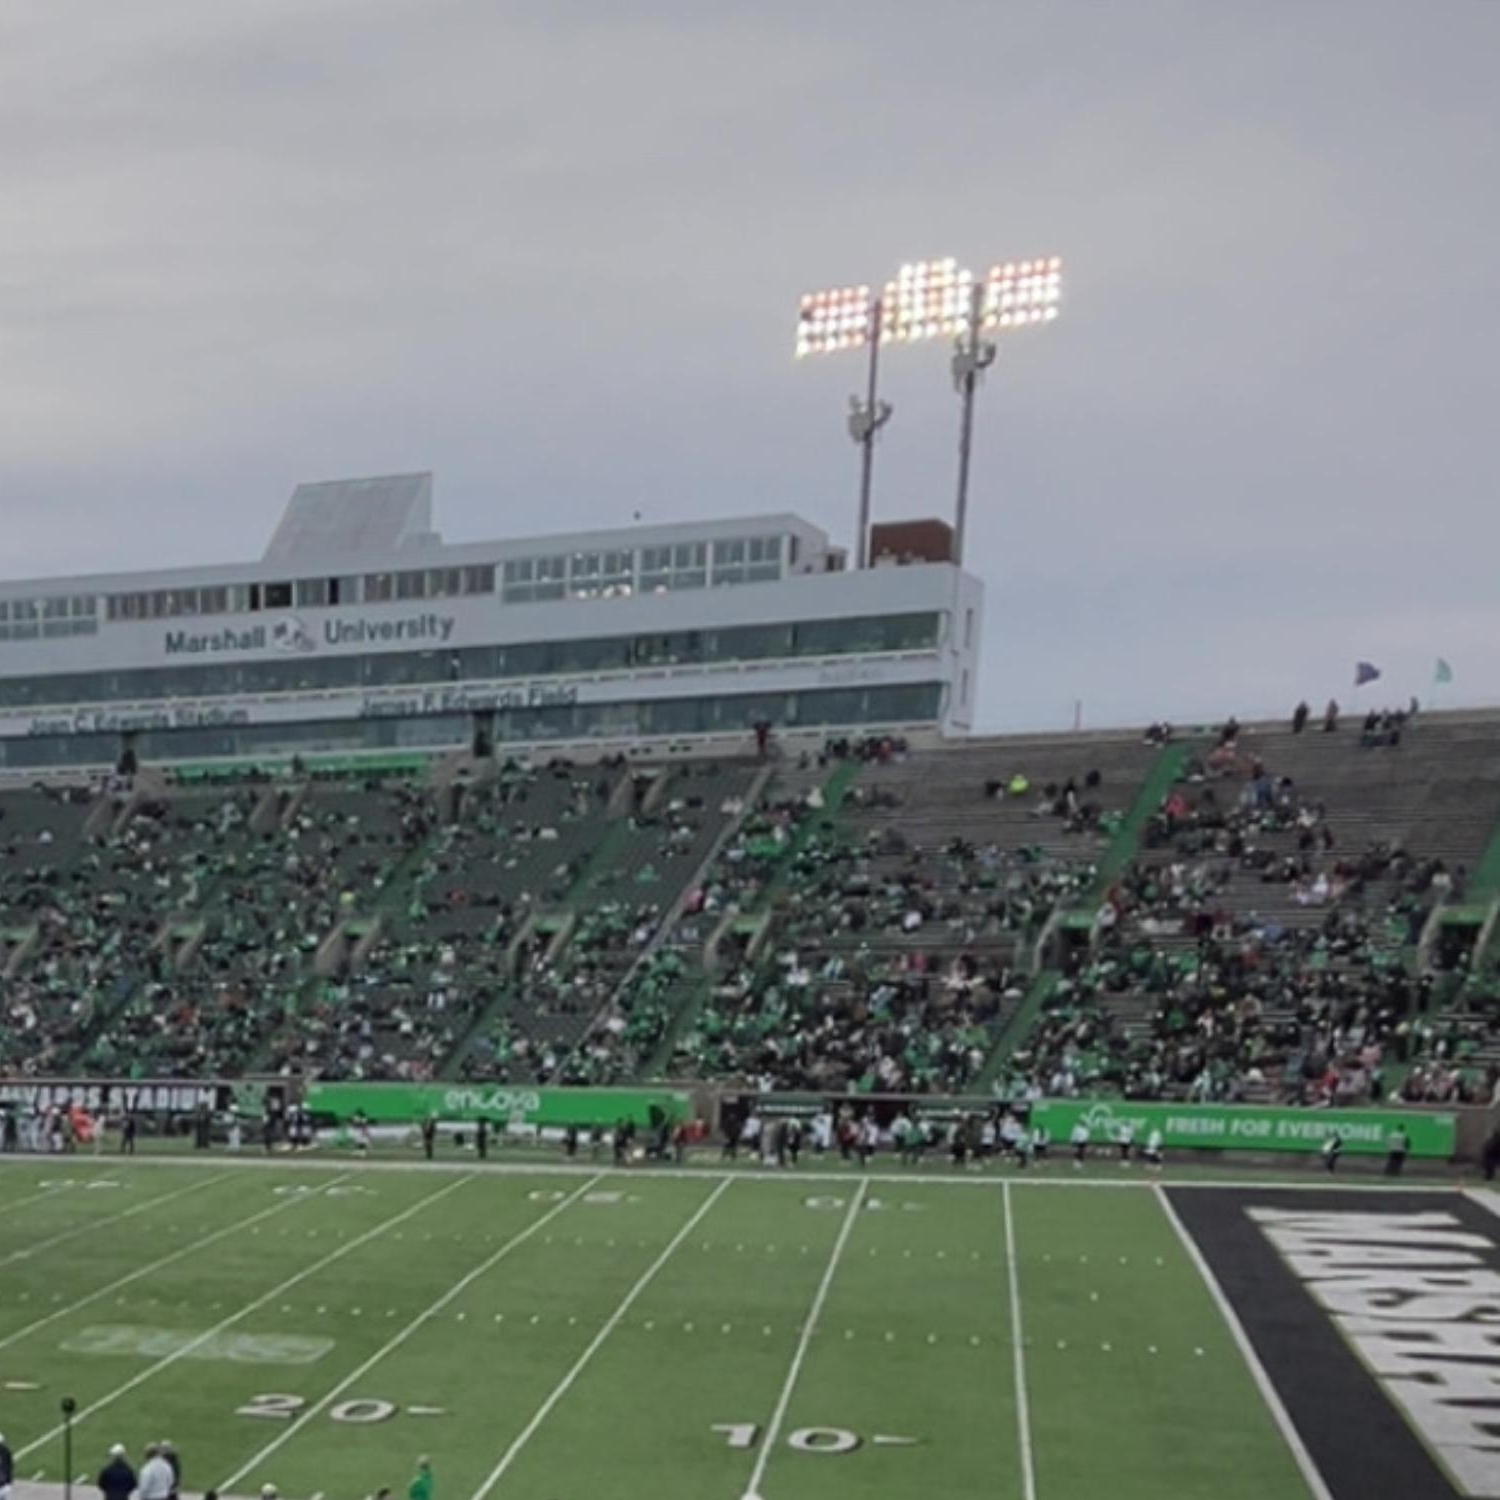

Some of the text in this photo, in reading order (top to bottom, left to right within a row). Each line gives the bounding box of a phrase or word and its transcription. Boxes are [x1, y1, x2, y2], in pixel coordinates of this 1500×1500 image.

[165, 614, 454, 653] Marshall University
[108, 1085, 217, 1110] STADIUM
[1165, 1116, 1382, 1142] FRESH FOR EVERYONE
[234, 1392, 395, 1422] 20
[710, 1422, 858, 1452] 10
